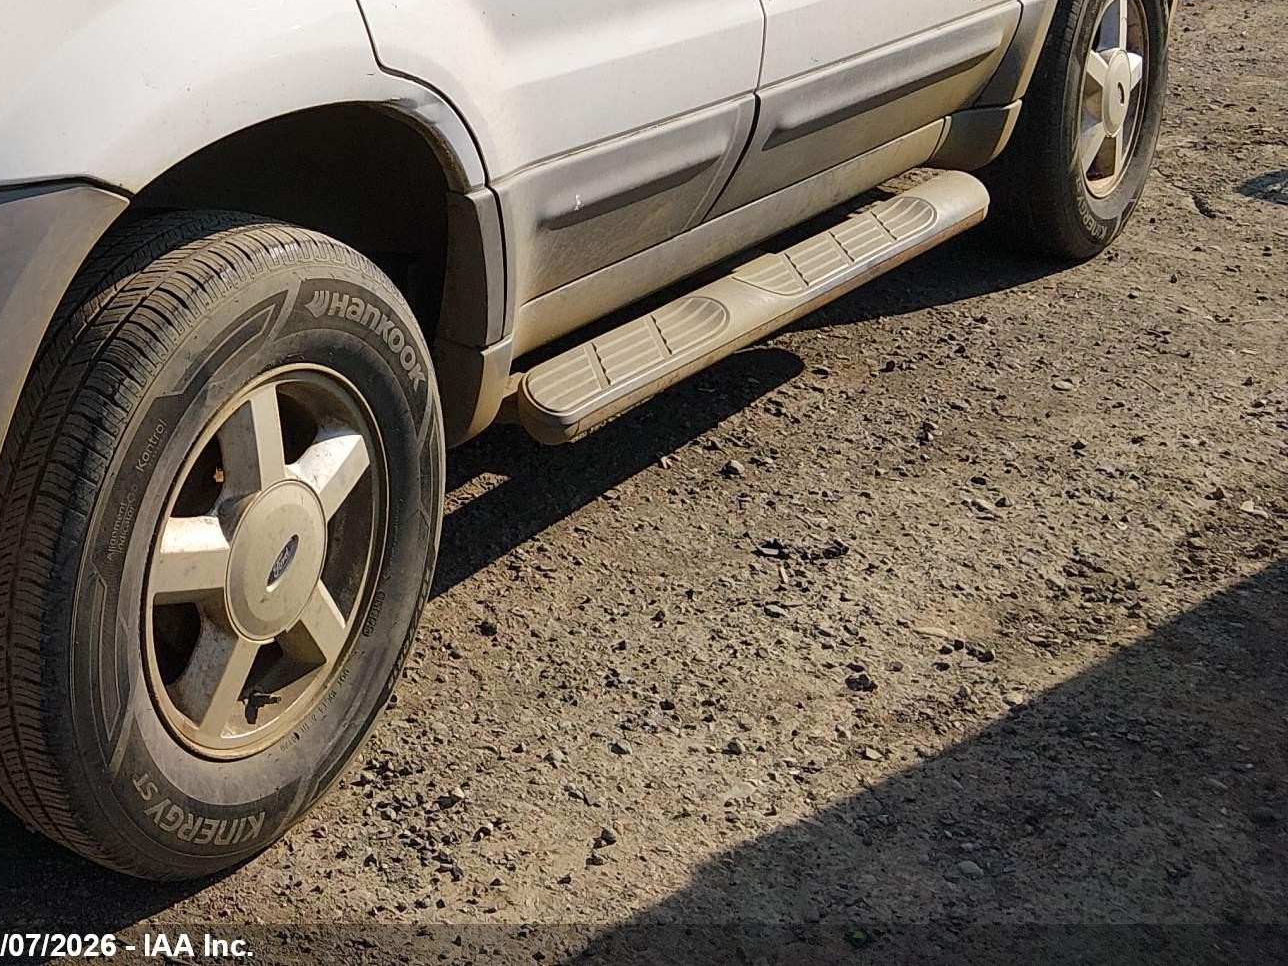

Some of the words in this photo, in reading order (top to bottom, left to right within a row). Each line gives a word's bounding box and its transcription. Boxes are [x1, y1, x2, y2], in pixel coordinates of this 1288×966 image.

[135, 417, 168, 472] Kontrol
[132, 773, 159, 802] ST
[144, 797, 266, 846] KINERGY
